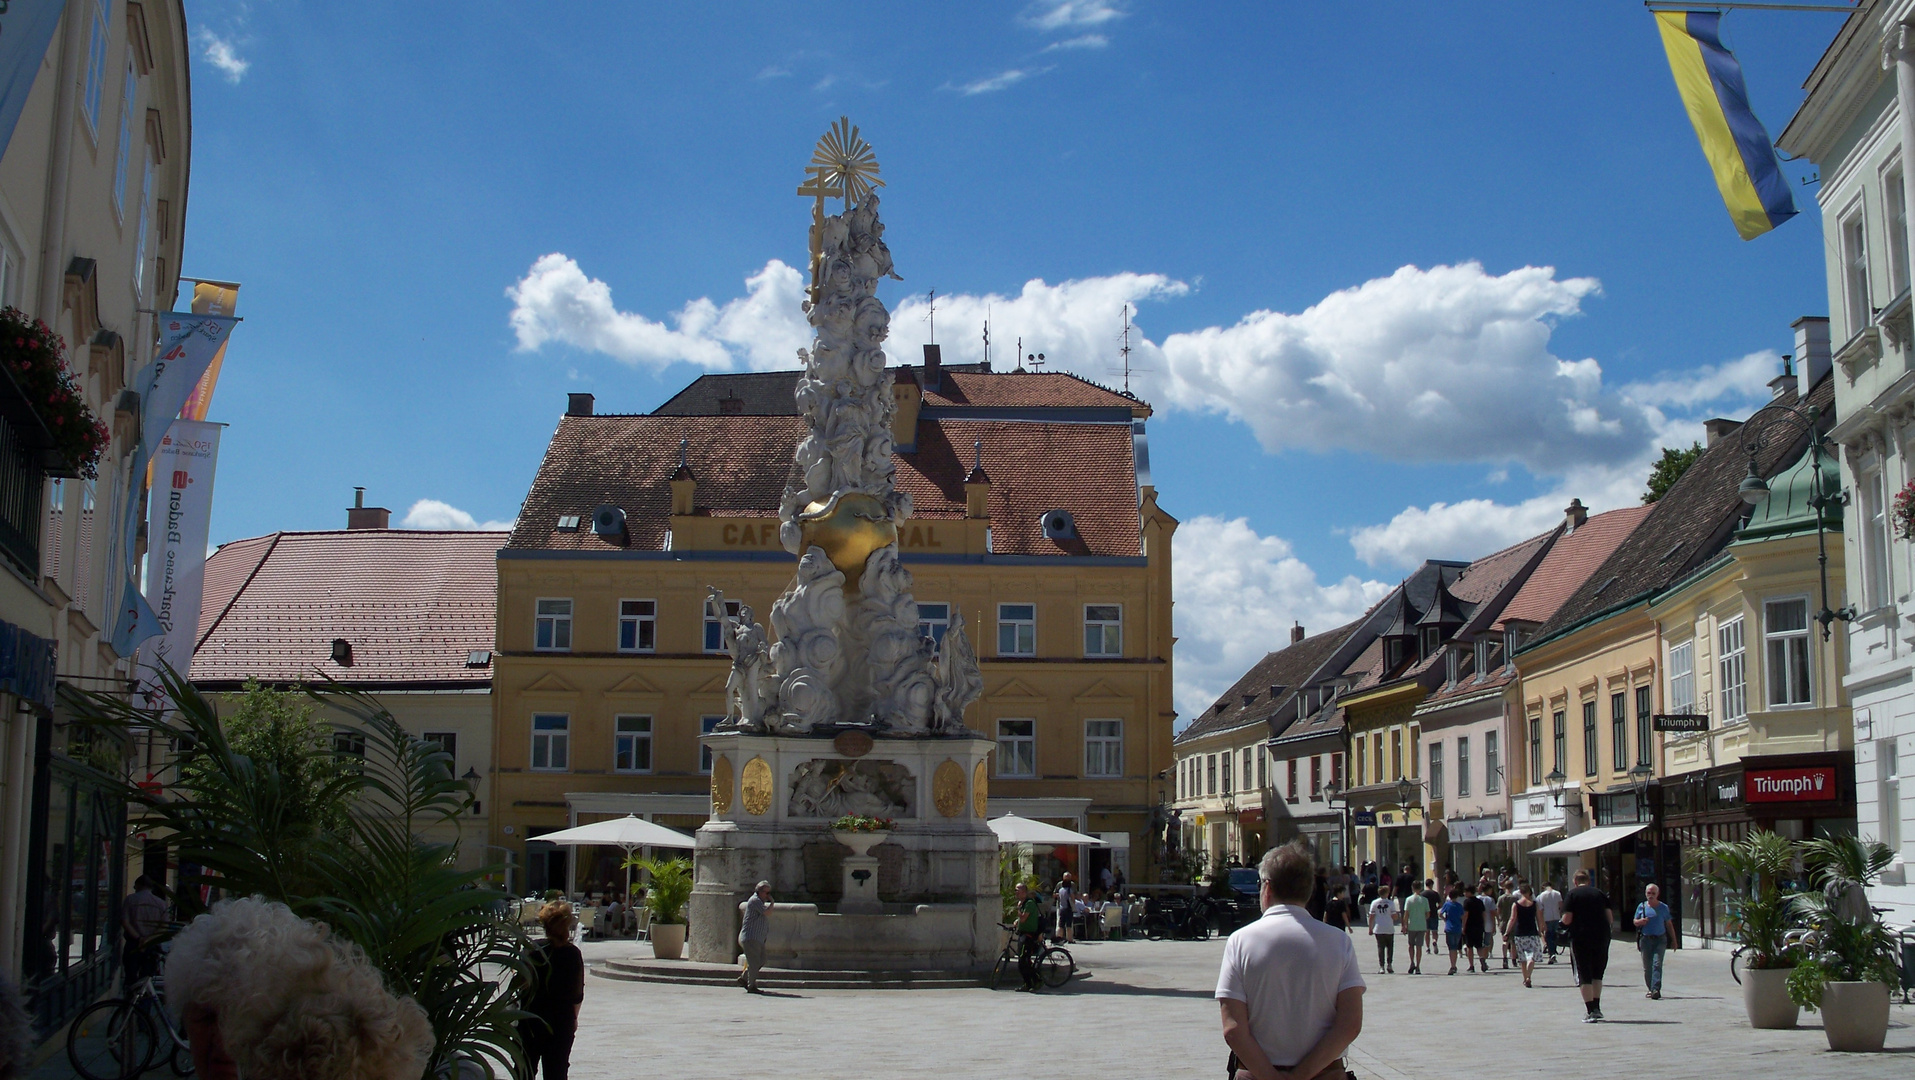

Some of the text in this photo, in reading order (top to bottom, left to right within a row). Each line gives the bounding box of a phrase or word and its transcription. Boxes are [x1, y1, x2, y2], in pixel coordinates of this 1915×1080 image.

[722, 523, 777, 546] CAF
[1659, 718, 1695, 727] Triumph
[1718, 784, 1736, 802] Triumph
[1754, 776, 1812, 795] Triumph
